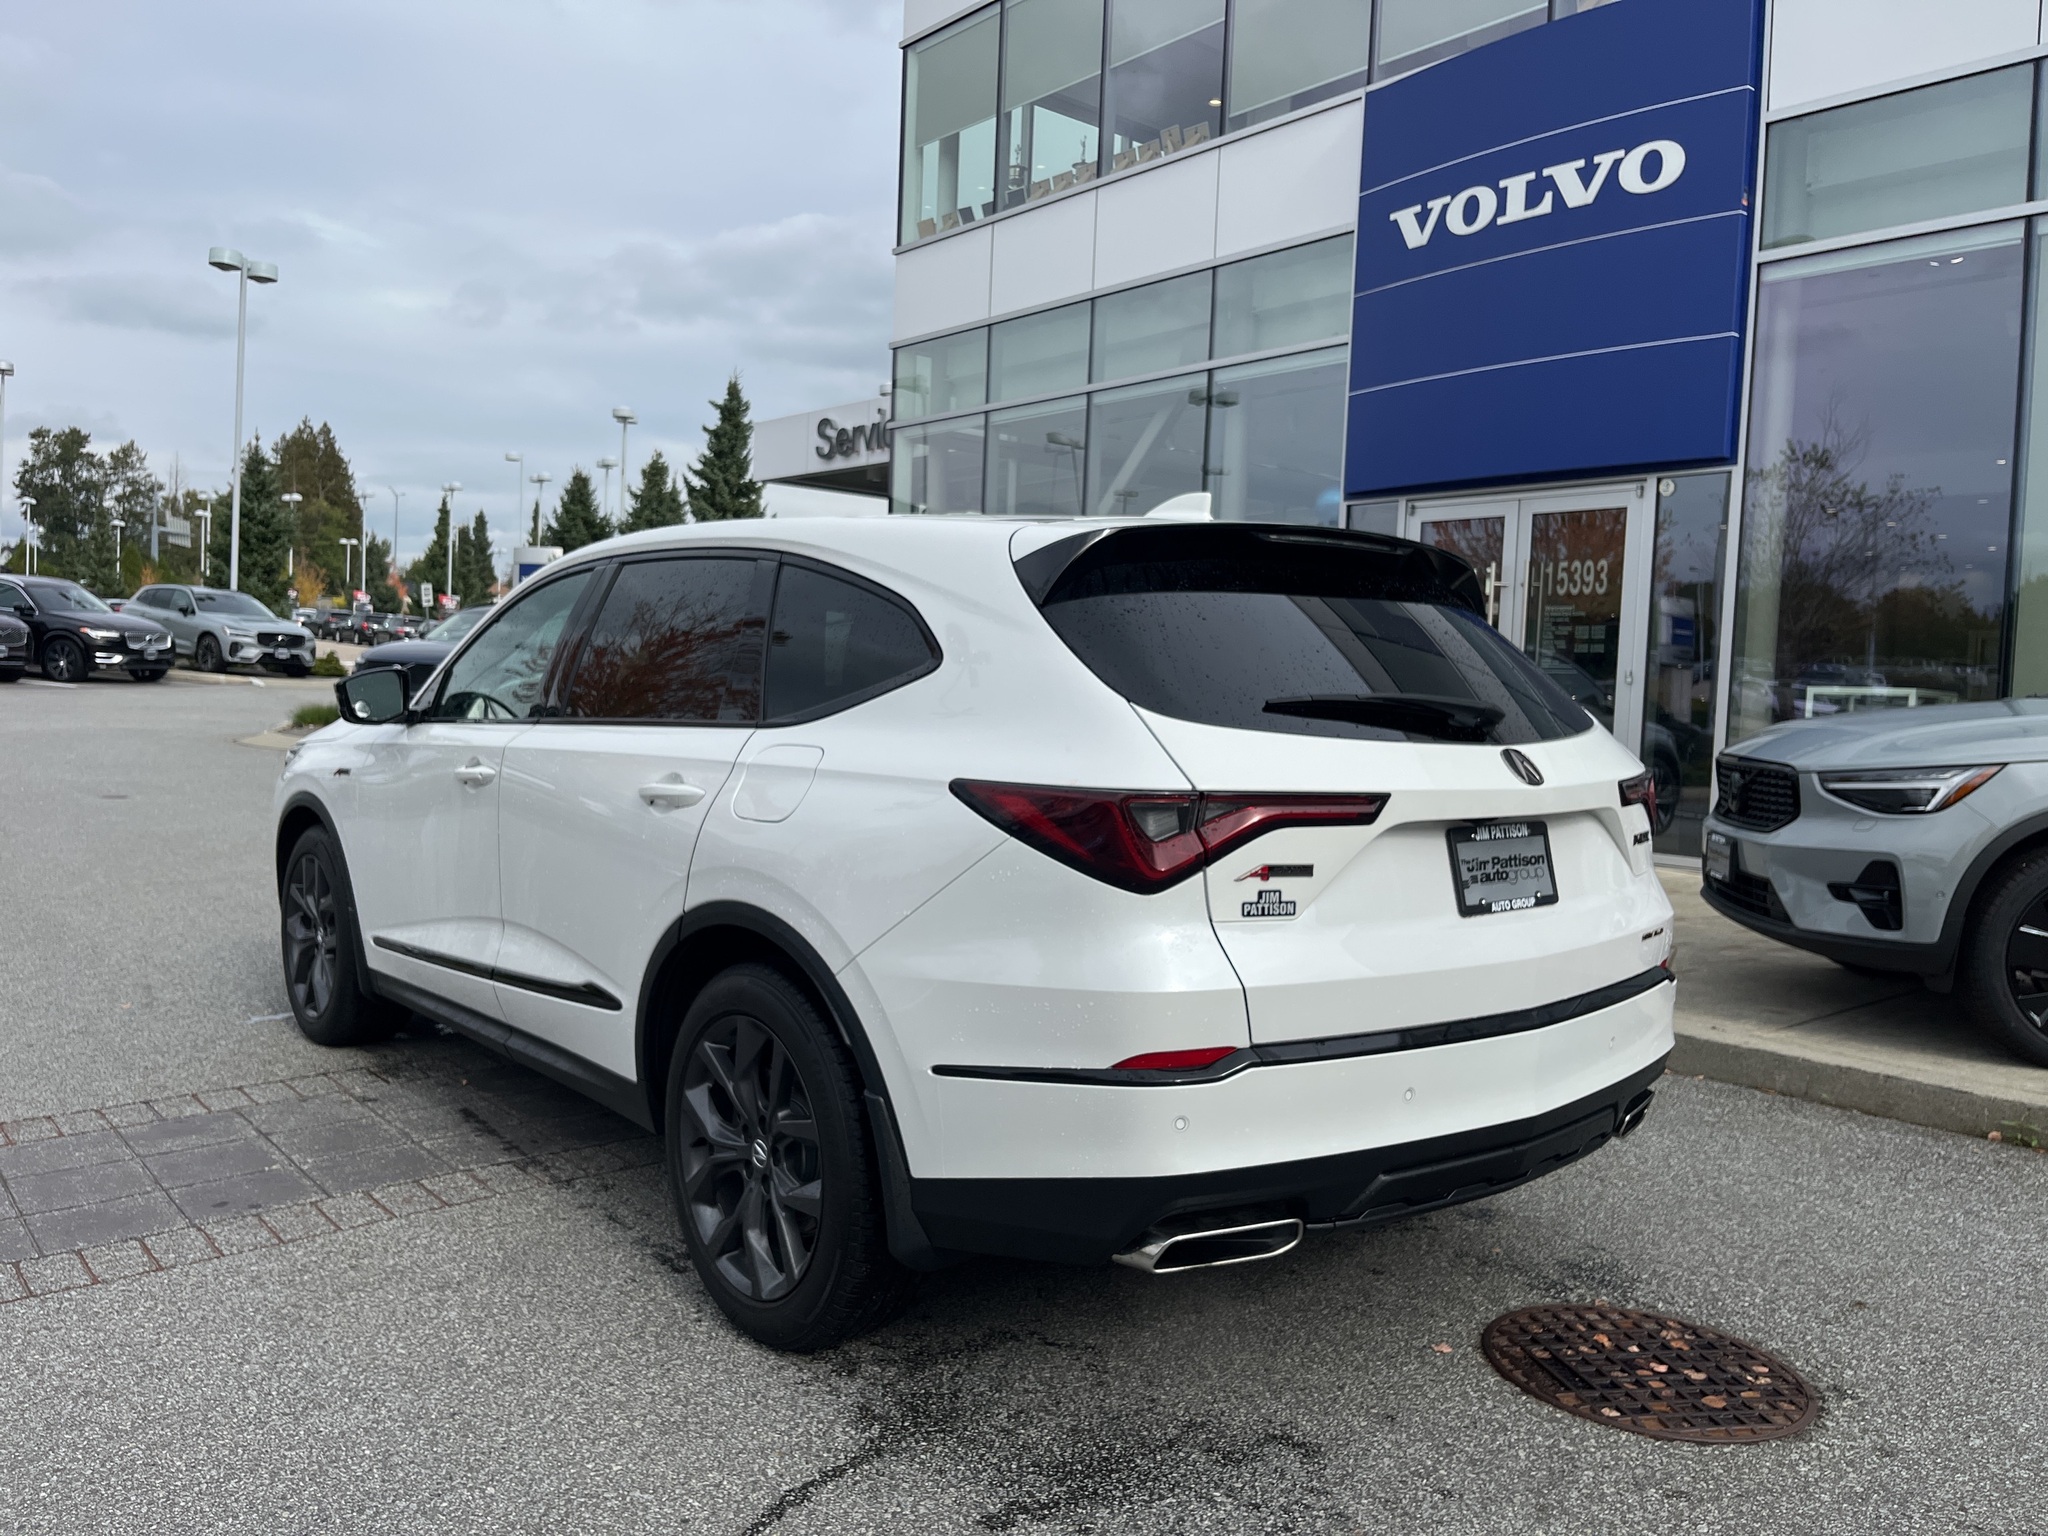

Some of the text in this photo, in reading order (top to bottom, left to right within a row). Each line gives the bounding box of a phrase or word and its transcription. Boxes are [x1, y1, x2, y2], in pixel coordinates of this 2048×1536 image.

[1389, 139, 1686, 249] VOLVO
[1545, 559, 1608, 596] 15393
[1475, 823, 1528, 841] JIM PATTISON
[1467, 857, 1489, 873] Jim
[1492, 854, 1544, 870] Pattison
[1259, 891, 1280, 904] JIM
[1492, 897, 1536, 912] AUTO GROUP
[1243, 903, 1295, 916] PATTISON
